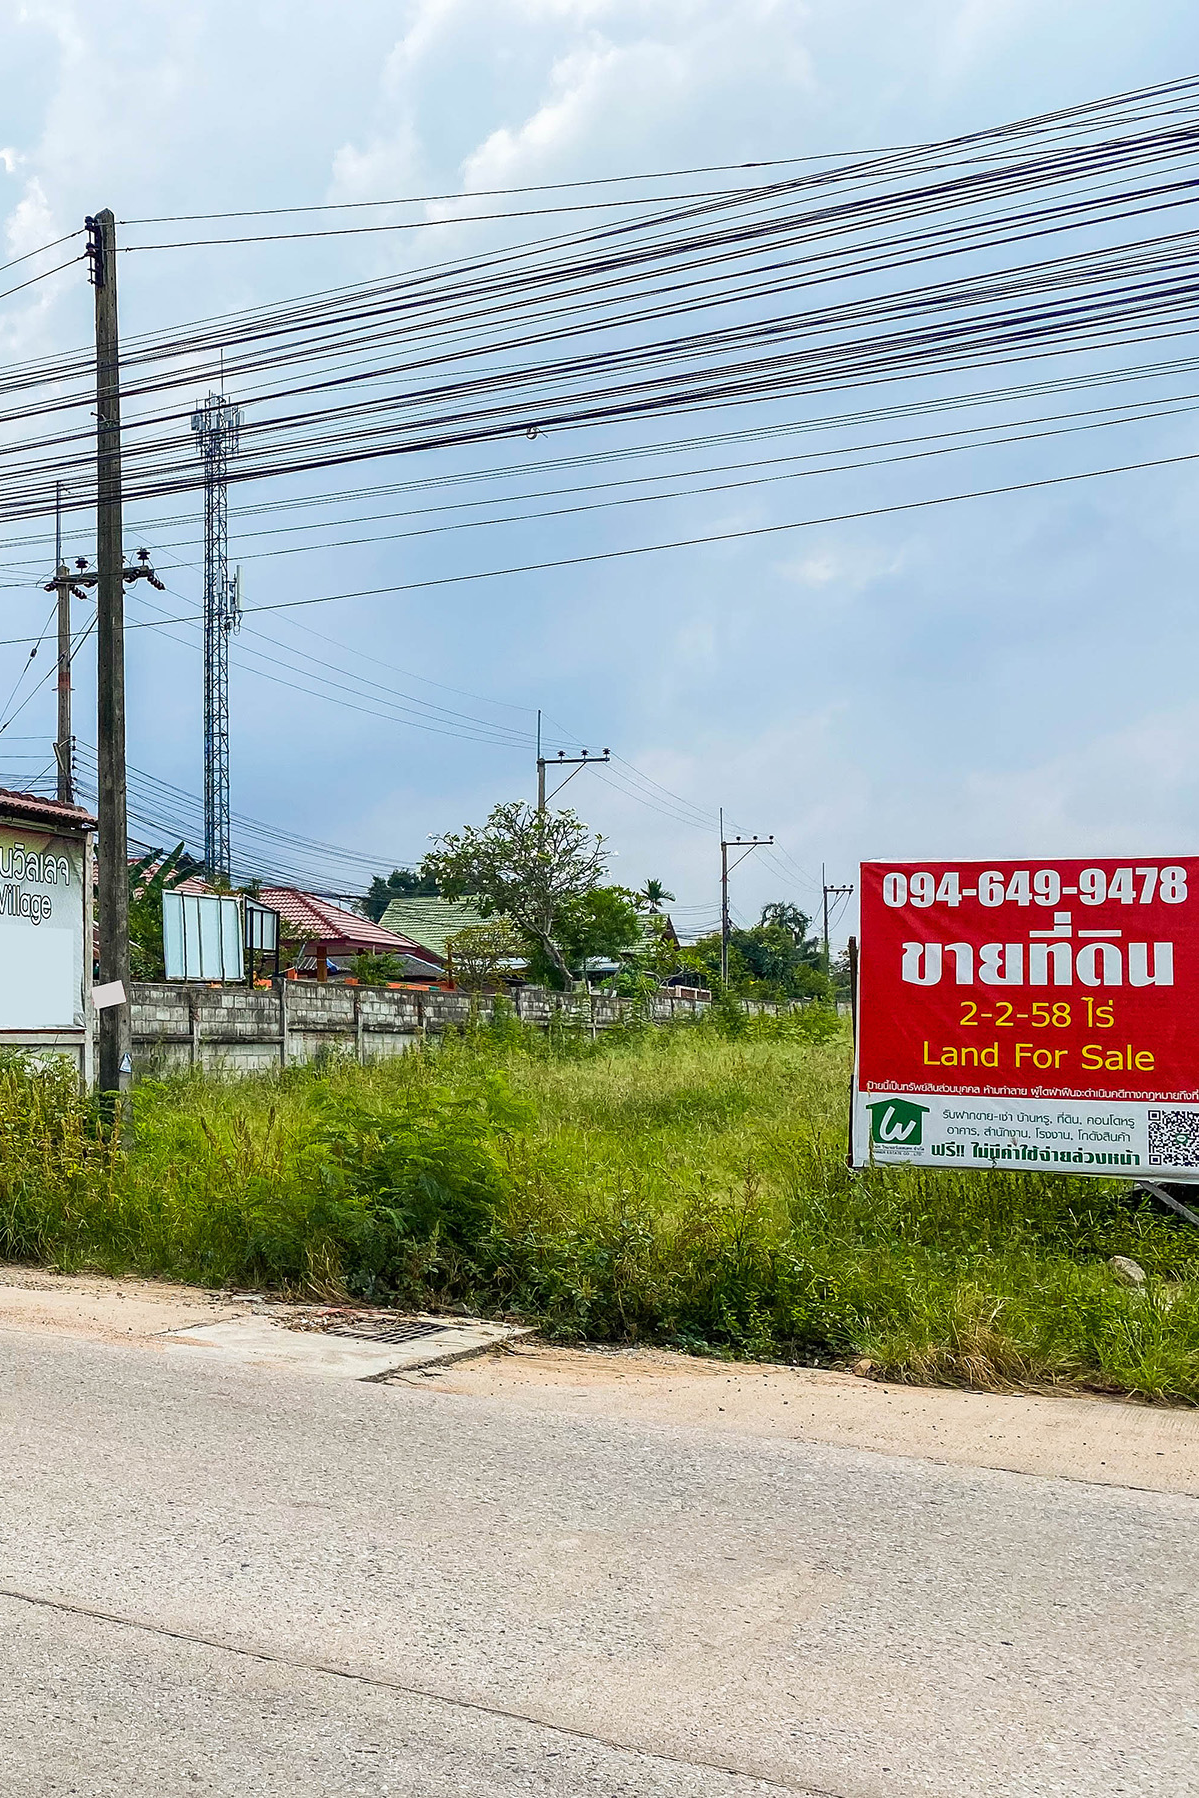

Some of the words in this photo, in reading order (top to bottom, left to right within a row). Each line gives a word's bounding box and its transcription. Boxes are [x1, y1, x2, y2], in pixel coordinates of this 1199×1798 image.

[882, 866, 1188, 908] 094-649-9478
[901, 911, 1175, 987] ขายที่ดิน
[959, 1001, 1071, 1027] 2-2-58
[1080, 996, 1115, 1029] ไร่
[923, 1041, 999, 1068] Land
[1015, 1043, 1068, 1069] For
[1081, 1044, 1155, 1071] Sale
[942, 1109, 1013, 1121] รับฝากขาย-เช่า
[1087, 1114, 1135, 1129] คอนโดหรู
[1078, 1129, 1131, 1142] โกดังสินค้า
[931, 1141, 965, 1157] ฟรี!!
[971, 1142, 1140, 1165] ไม่มีค่าใช้จ่ายล่วงหน้า
